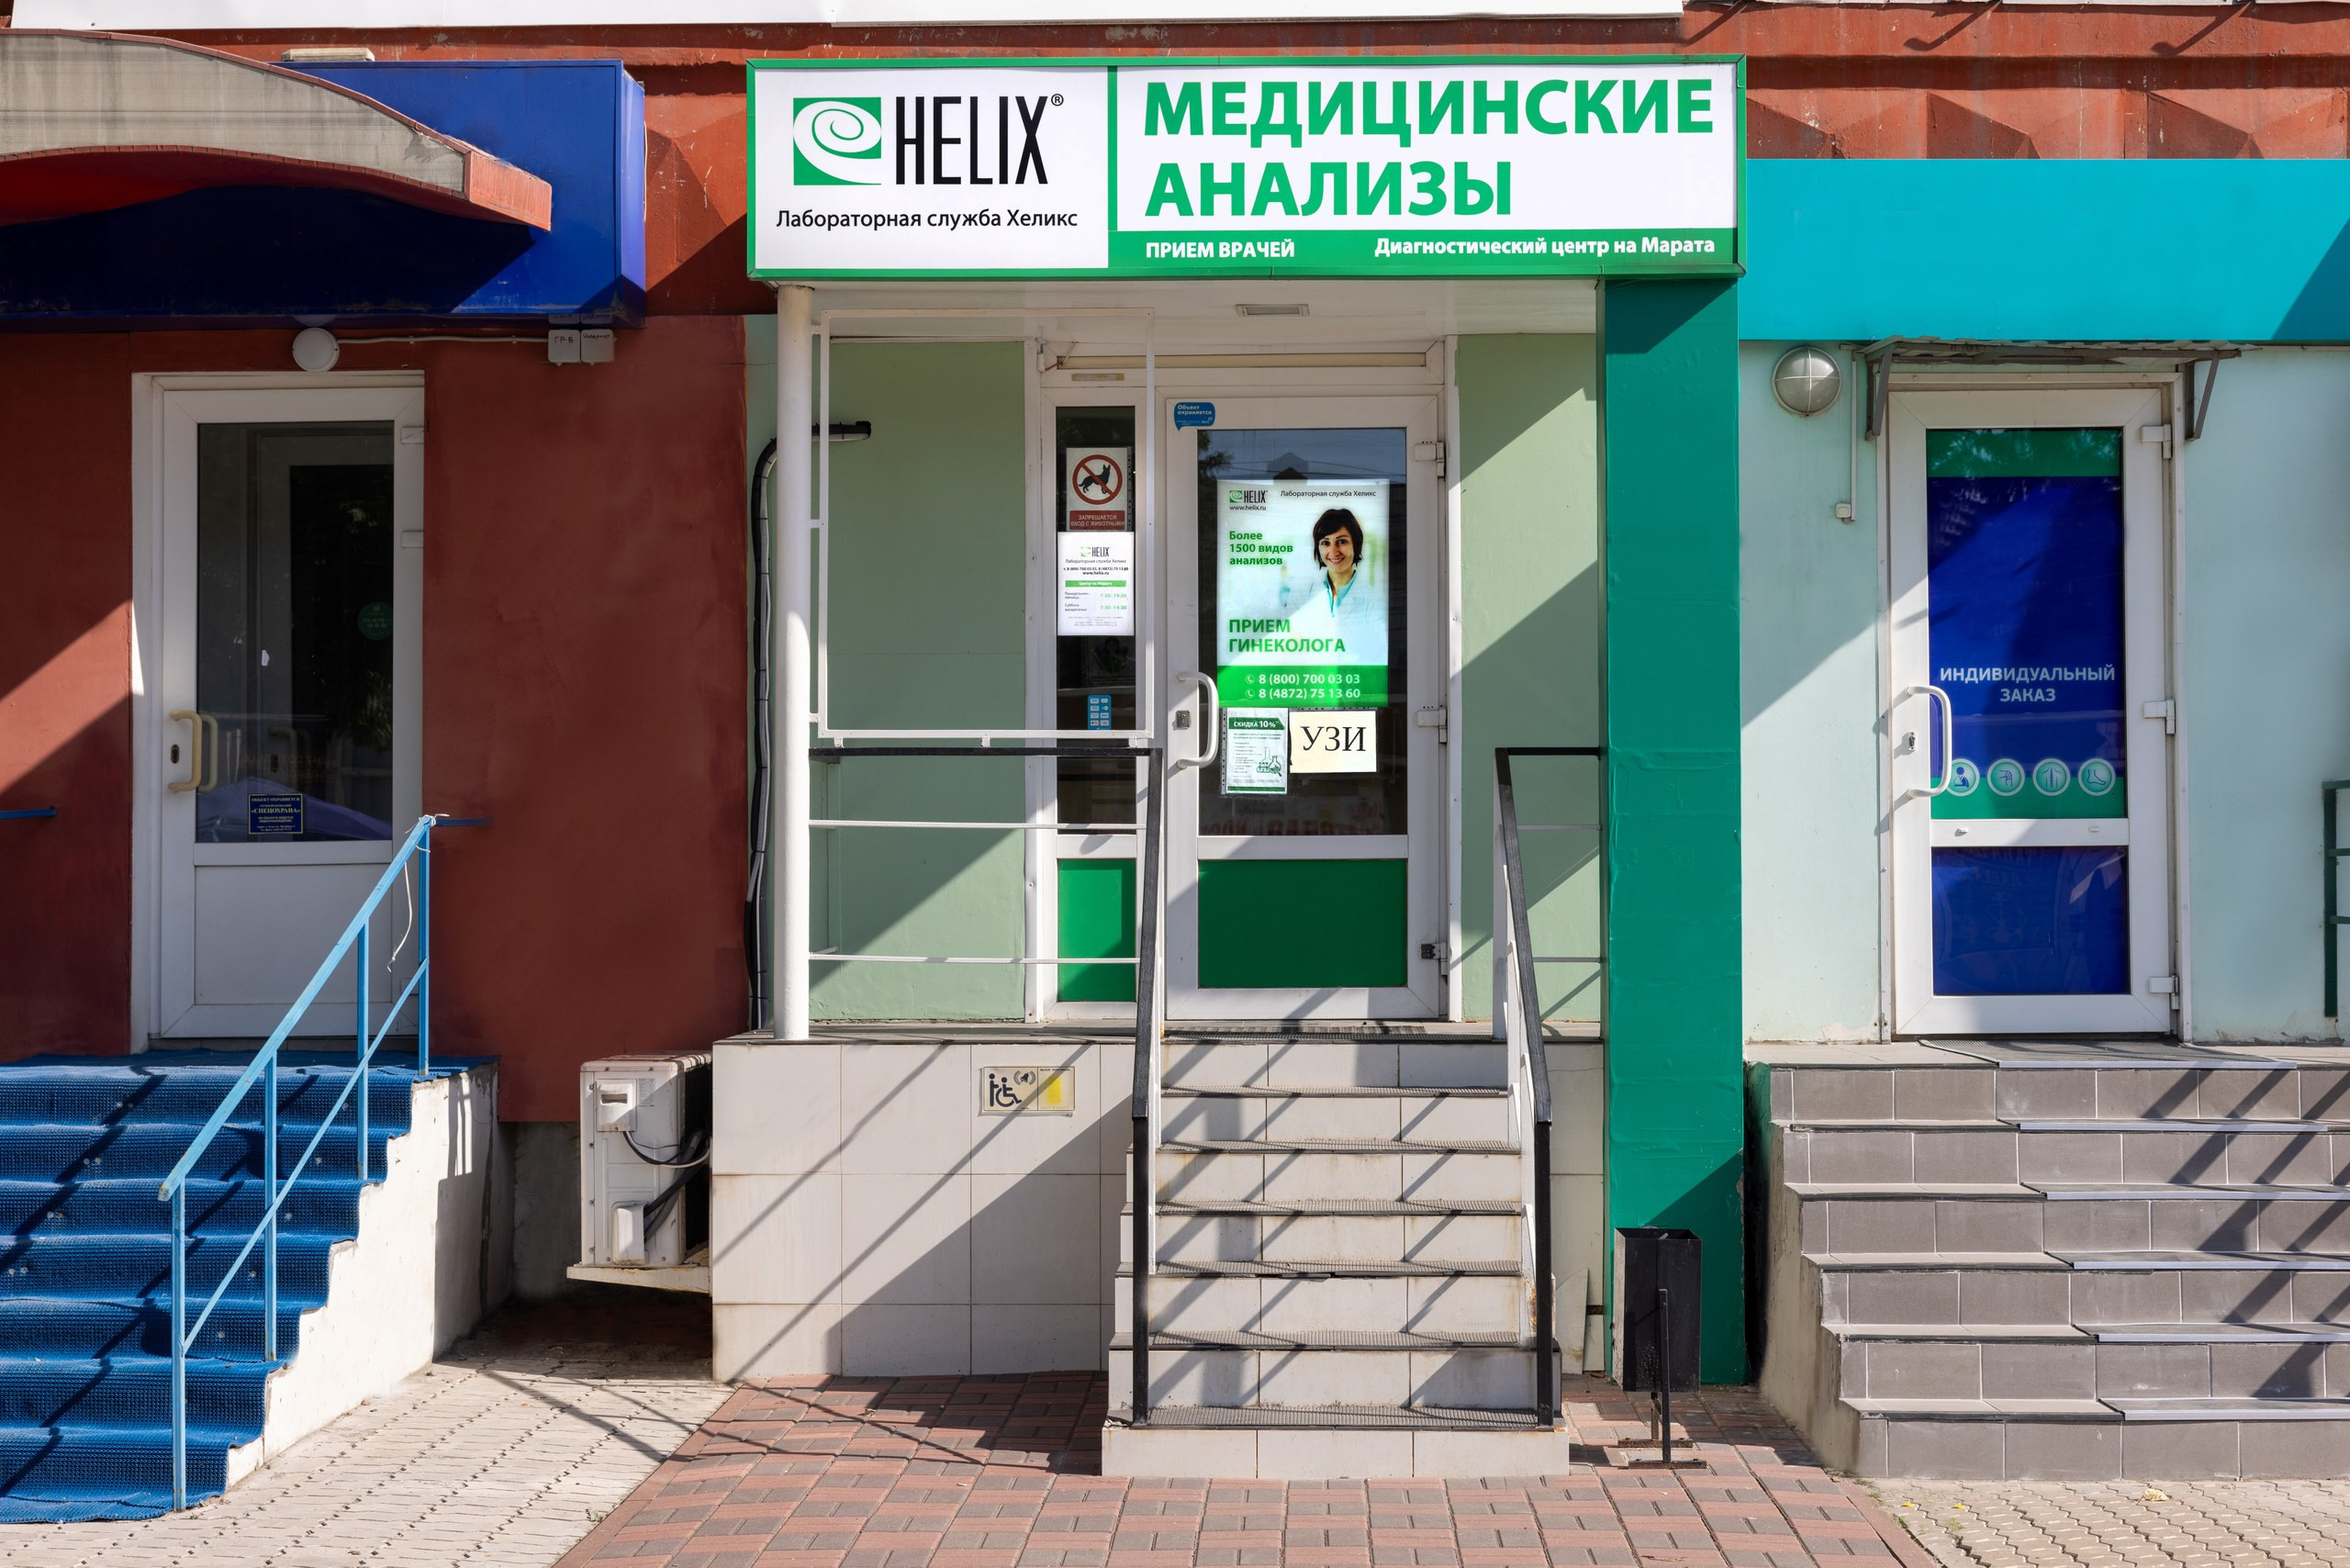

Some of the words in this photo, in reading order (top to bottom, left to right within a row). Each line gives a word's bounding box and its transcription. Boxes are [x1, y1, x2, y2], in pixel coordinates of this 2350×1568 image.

[1145, 79, 1713, 148] МЕДИЦИНСКИЕ
[1145, 161, 1511, 217] АНАЛИЗЫ
[777, 209, 921, 230] Лабораторная
[927, 208, 1002, 230] служба
[1007, 209, 1078, 227] Хеликс
[1146, 241, 1214, 258] ПРИЕМ
[1219, 239, 1295, 258] ВРАЧЕЙ
[1374, 238, 1547, 257] Диагностический
[1551, 241, 1609, 257] центр
[1614, 241, 1637, 253] на
[1641, 237, 1716, 256] Марата
[1229, 531, 1262, 540] Более
[1091, 546, 1110, 557] HELIX
[1229, 543, 1256, 553] 1500
[1229, 557, 1282, 566] анализов
[1229, 619, 1291, 633] ПРИЕМ
[1229, 638, 1346, 652] ГИНЕКОЛОГА
[1259, 674, 1266, 684] 8
[1269, 673, 1299, 685] (800)
[1304, 674, 1325, 684] 700
[1327, 674, 1342, 684] 03
[1346, 674, 1360, 684] 03
[1940, 664, 2115, 683] ИНДИВИДУАЛЬНЫЙ
[1259, 689, 1266, 699] 8
[1269, 688, 1307, 700] (4872)
[1310, 689, 1325, 699] 75
[1328, 689, 1342, 699] 13
[1346, 689, 1360, 699] 60
[2000, 689, 2056, 702] ЗАКАЗ
[1300, 726, 1367, 752] УЗИ
